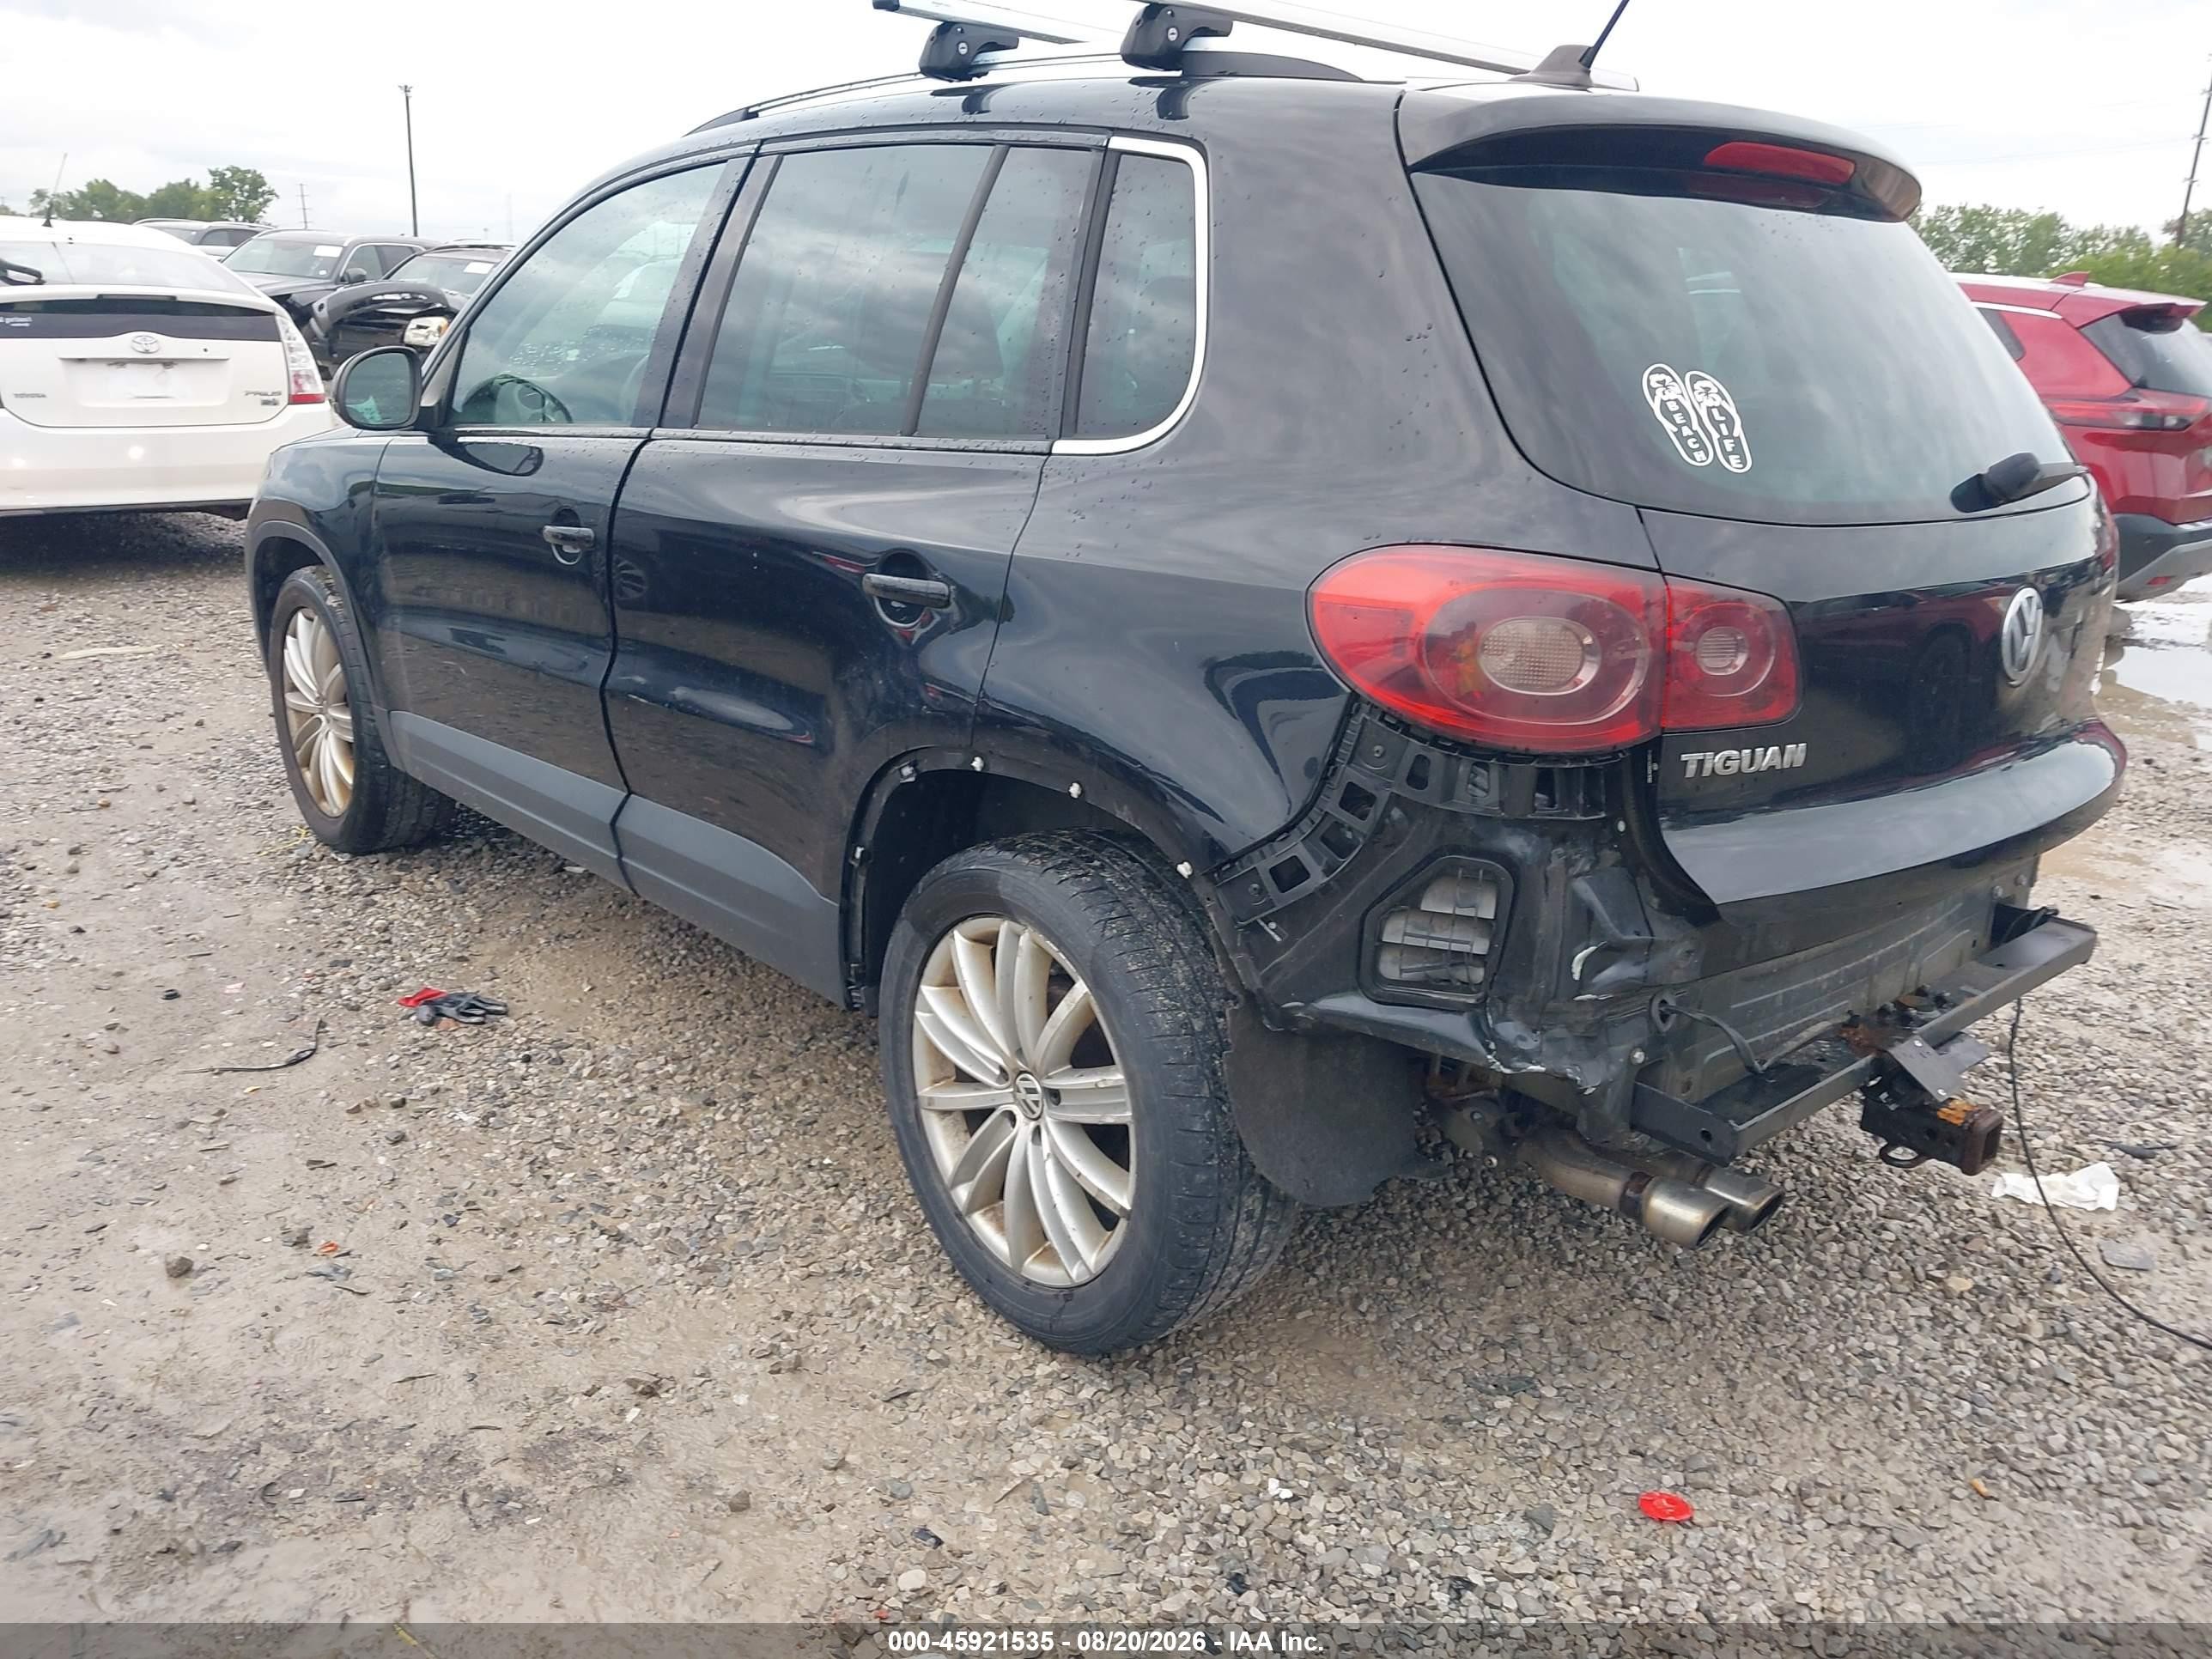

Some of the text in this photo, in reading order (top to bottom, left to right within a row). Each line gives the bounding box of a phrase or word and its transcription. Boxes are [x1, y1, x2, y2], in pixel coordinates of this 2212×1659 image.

[1665, 401, 1707, 463] BEACH
[1711, 408, 1744, 468] LIFE
[1680, 742, 1808, 779] TIGUAN
